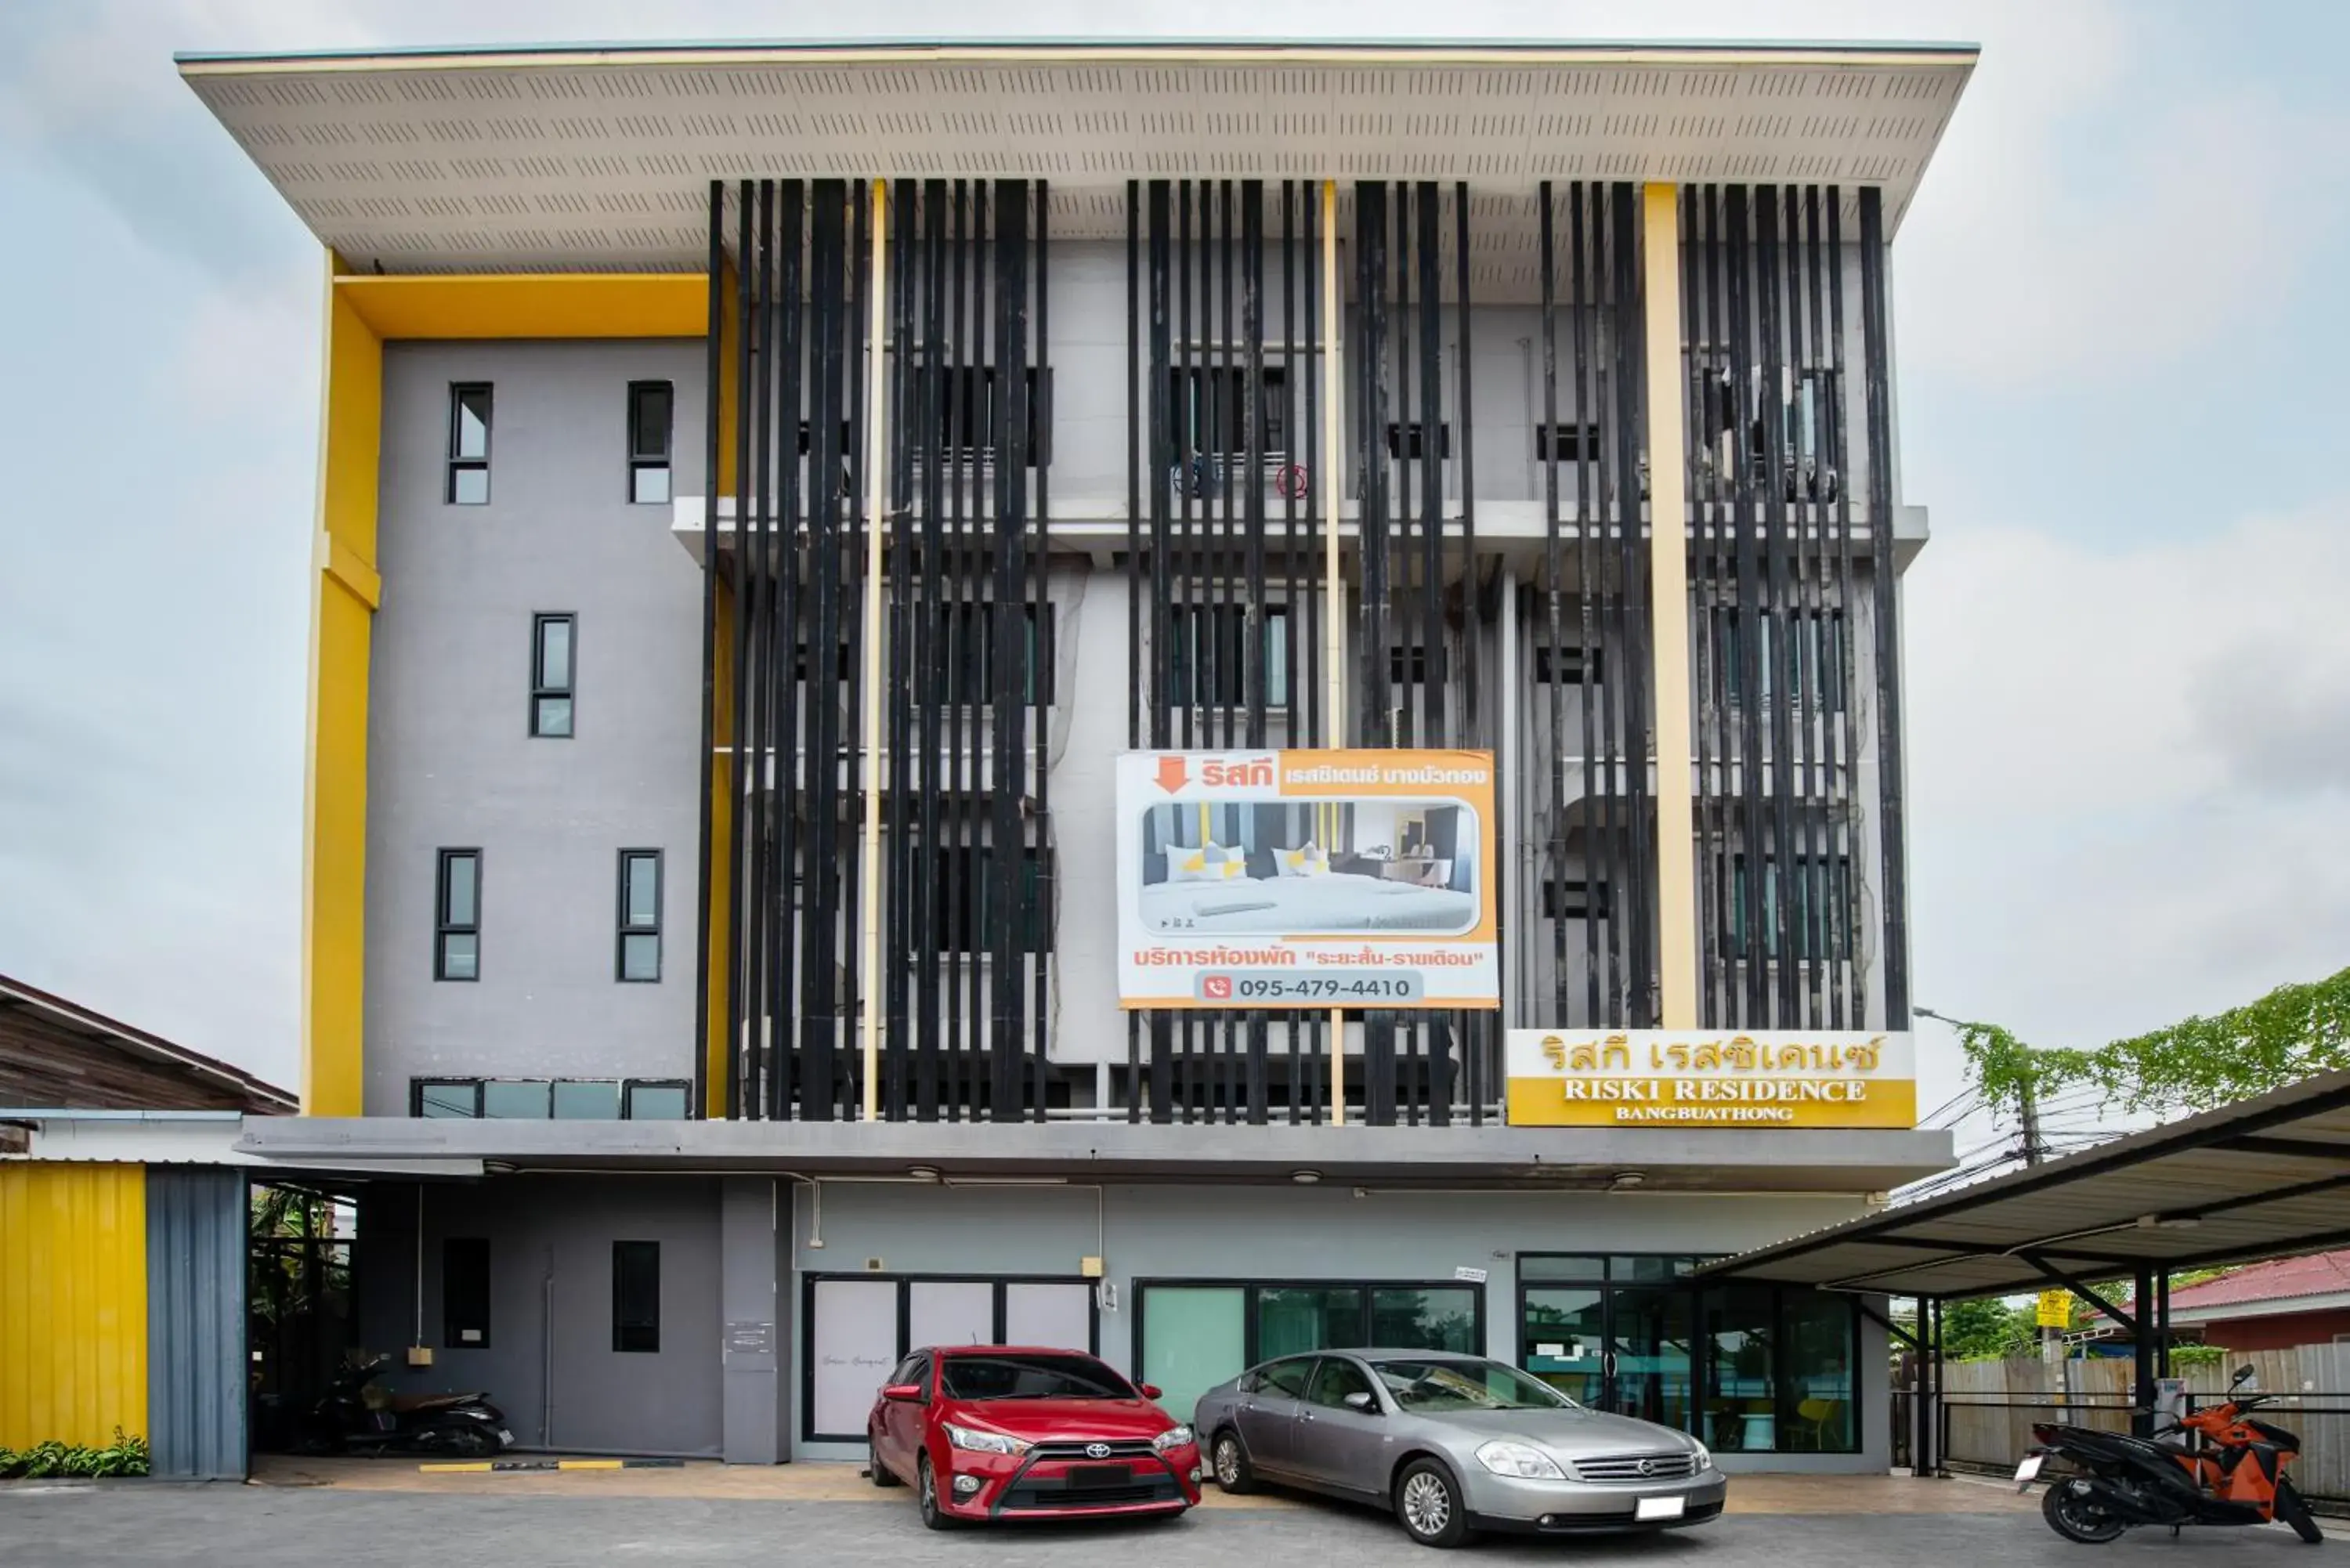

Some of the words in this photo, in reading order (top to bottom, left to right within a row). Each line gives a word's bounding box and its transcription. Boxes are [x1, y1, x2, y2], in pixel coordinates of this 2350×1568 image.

[1202, 757, 1273, 786] ริสกี
[1383, 764, 1488, 784] บางบัวทอง
[1133, 945, 1296, 966] บริการห้องพัก
[1239, 980, 1410, 997] 095-479-4410
[1541, 1032, 1630, 1071] ริสกี
[1564, 1079, 1660, 1101] RISKI
[1673, 1079, 1867, 1102] RESIDENCE
[1616, 1107, 1794, 1121] BANGBUATHONG
